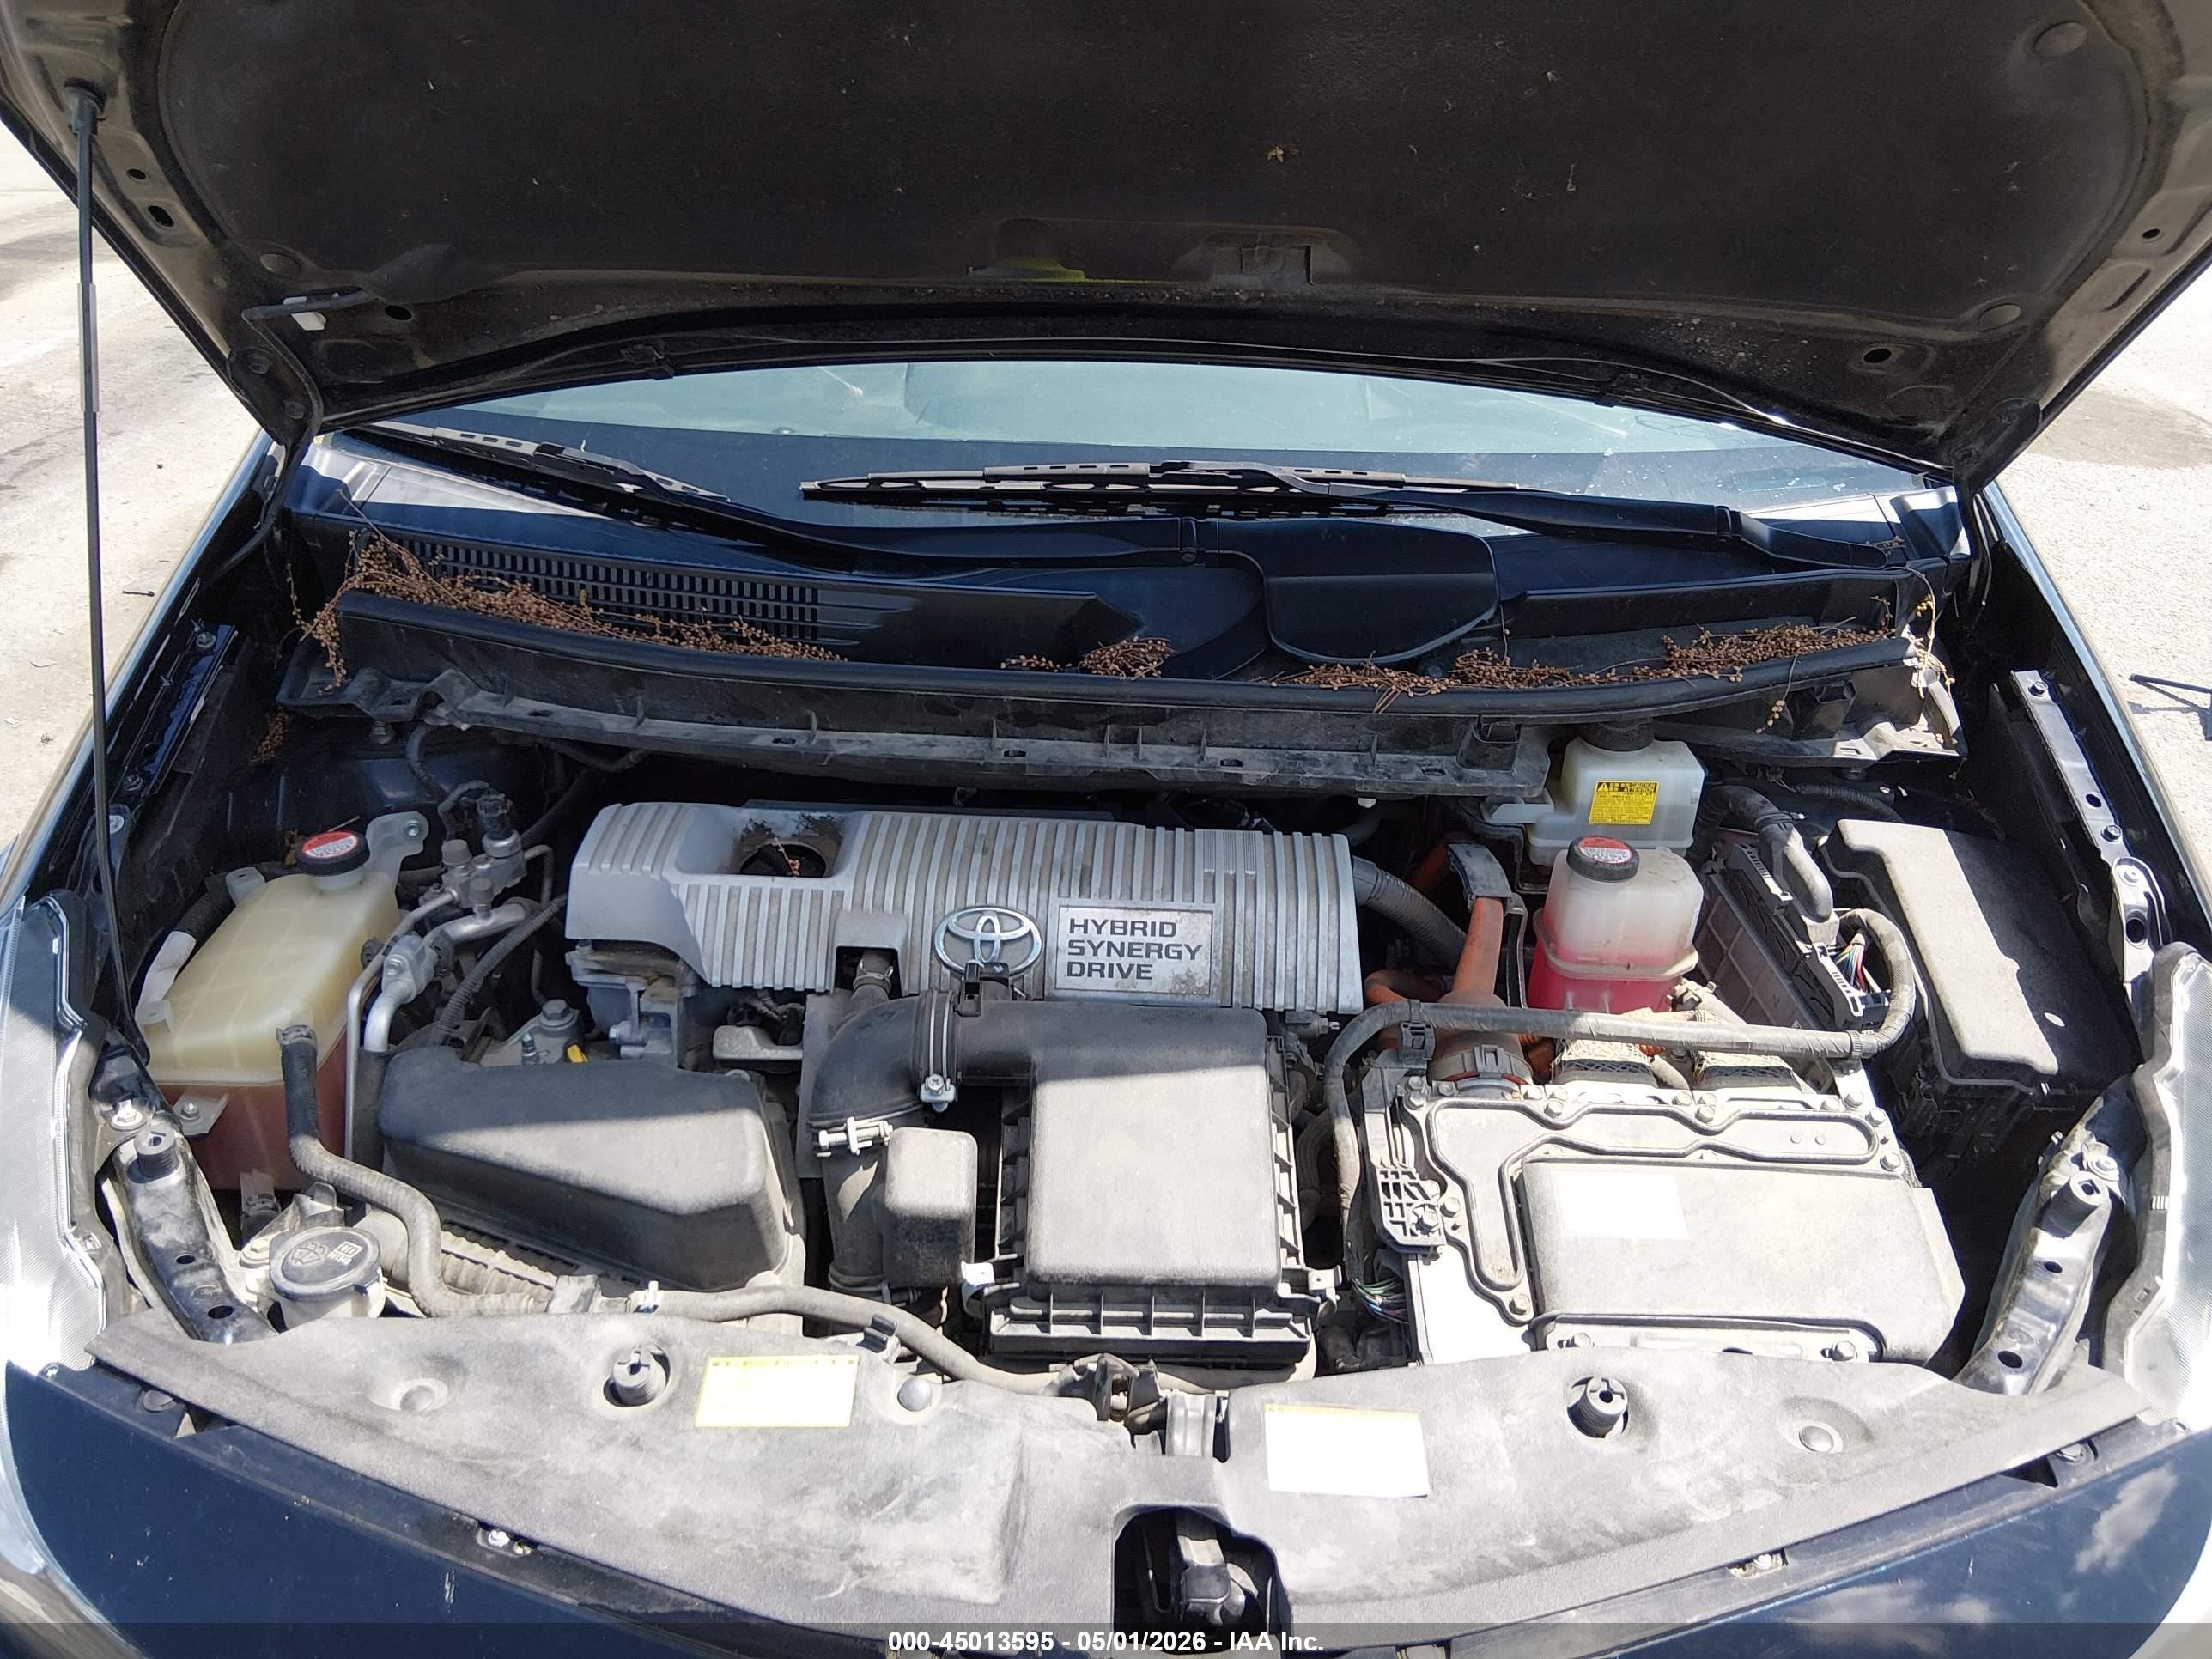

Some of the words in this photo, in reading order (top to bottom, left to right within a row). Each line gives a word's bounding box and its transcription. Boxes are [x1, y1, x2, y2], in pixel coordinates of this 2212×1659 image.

[1069, 918, 1177, 938] HYBRID
[1067, 939, 1203, 960] SYNERGY
[1066, 961, 1153, 980] DRIVE
